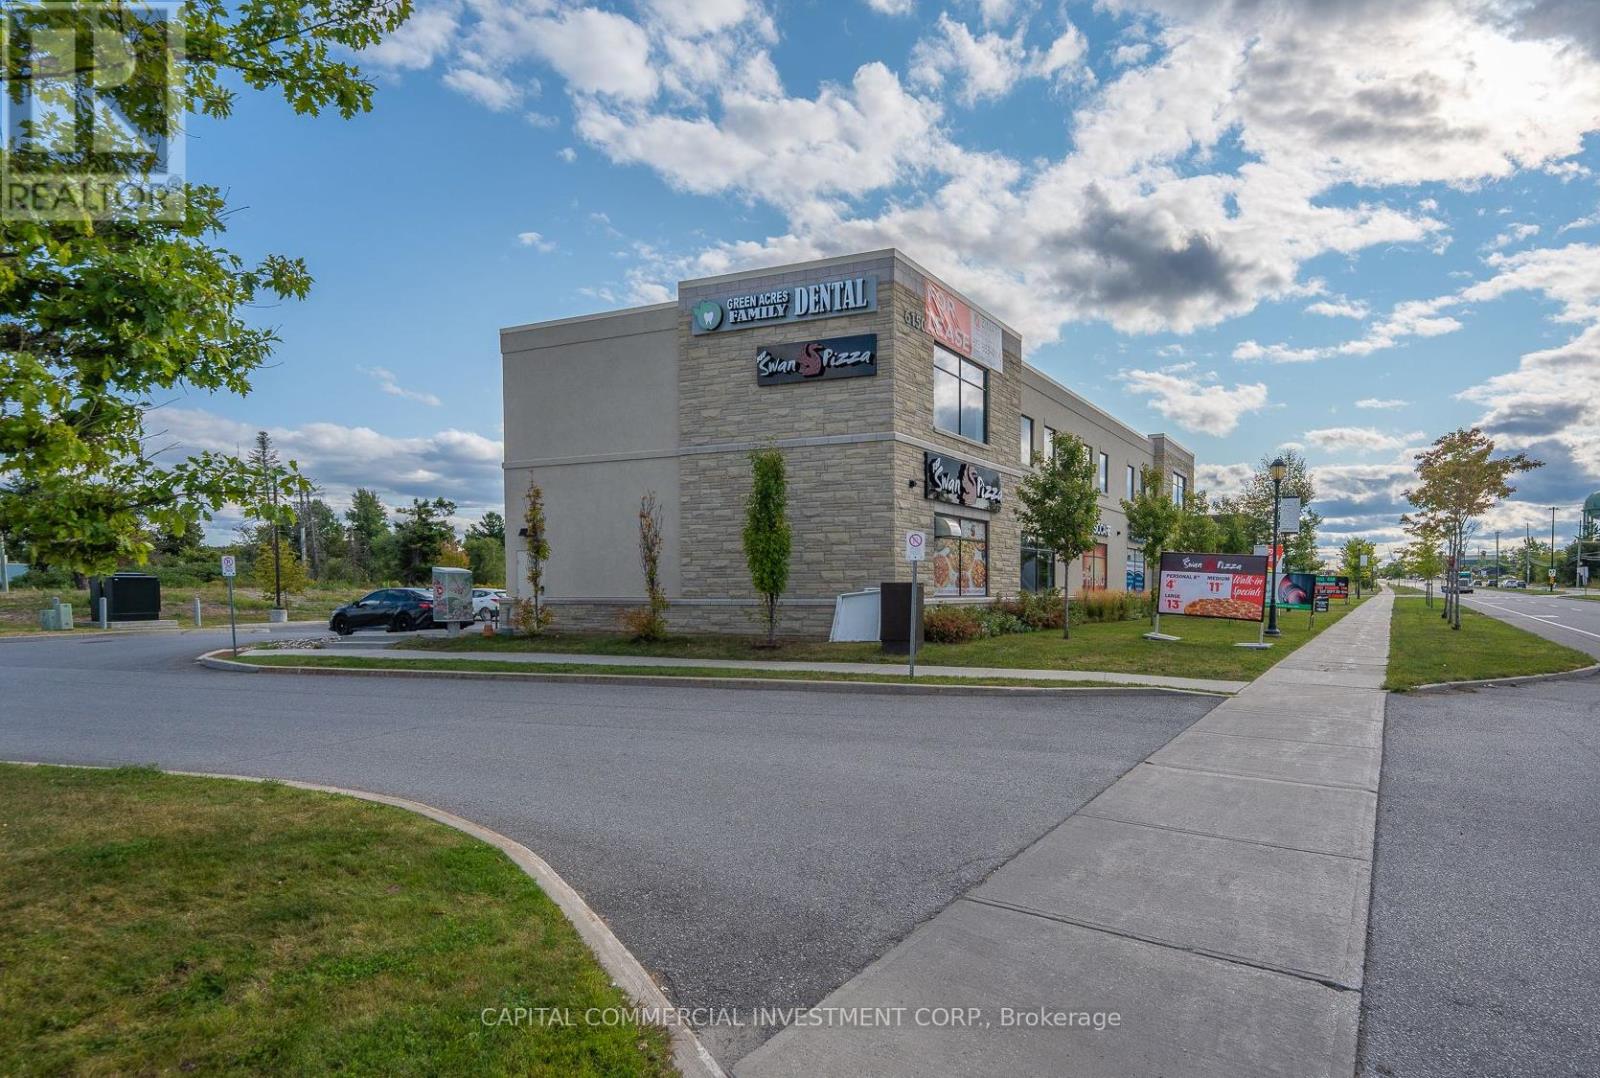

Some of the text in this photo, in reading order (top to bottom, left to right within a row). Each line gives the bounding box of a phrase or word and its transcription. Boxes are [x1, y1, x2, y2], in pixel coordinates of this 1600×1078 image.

[727, 291, 789, 310] GREEN ACRES
[794, 278, 867, 316] DENTAL
[729, 304, 788, 323] FAMILY
[758, 352, 796, 376] Swan
[822, 348, 870, 368] Pizza
[934, 465, 961, 496] Swan
[977, 475, 1003, 501] Pizza
[1233, 586, 1262, 599] Specials
